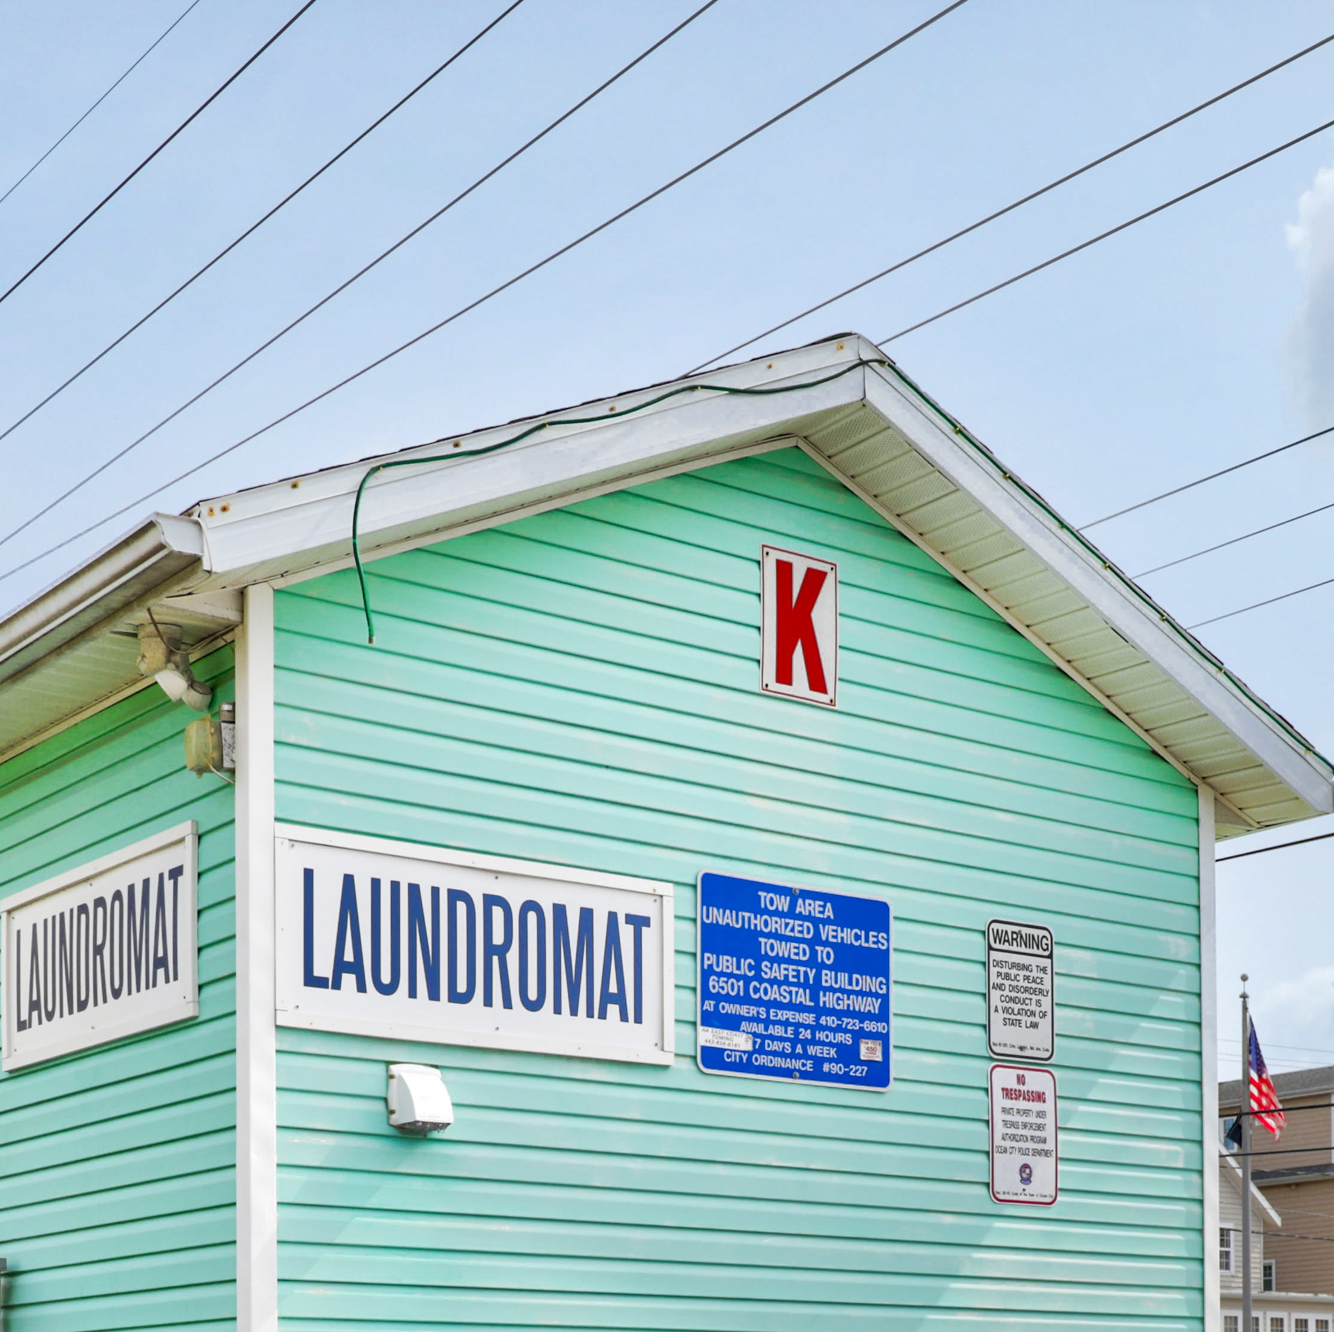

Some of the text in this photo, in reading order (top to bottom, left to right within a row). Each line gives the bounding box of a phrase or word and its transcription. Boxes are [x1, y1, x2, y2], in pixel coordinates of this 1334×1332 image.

[775, 558, 828, 695] K
[758, 891, 834, 919] TOW AREA
[702, 905, 888, 949] UNAUTHORIZED VEHICLES
[16, 863, 184, 1033] LAUNDROMAT
[303, 867, 651, 1025] LAUNDROMAT
[991, 927, 1050, 952] WARNING
[758, 937, 834, 964] TOWED TO
[703, 952, 887, 994] PUBLIC SAFETY BUILDING
[992, 959, 1048, 975] DISTURBING THE
[997, 971, 1044, 985] PUBLIC PEACE
[709, 975, 881, 1014] 6501 COASTAL HIGHWAY
[992, 982, 1049, 997] AND DISORDERLY
[1000, 994, 1042, 1008] CONDUCT IS
[703, 1000, 888, 1033] AT OWNER'S EXPENSE 410-723-6610
[994, 1005, 1048, 1019] A VIOLATION OF
[739, 1021, 794, 1038] AVAILABLE
[799, 1027, 812, 1039] 24
[816, 1030, 852, 1044] HOURS
[1003, 1017, 1039, 1030] STATE LAW
[712, 1034, 734, 1042] TOWING
[754, 1038, 762, 1049] 7
[765, 1040, 792, 1053] DAYS
[795, 1043, 803, 1054] A
[807, 1044, 837, 1058] WEEK
[723, 1050, 868, 1077] CITY ORDINANCE #90-227
[1016, 1074, 1026, 1086] NO
[1001, 1087, 1046, 1104] TRESPASSING
[1001, 1106, 1047, 1119] PRIVATE PROPERTY UNDER
[1002, 1119, 1047, 1132] TRESPASS ENFORCEMENT
[1001, 1133, 1047, 1145] AUTHORIZATION PROGRAM
[995, 1145, 1008, 1154] OCEAN
[1009, 1146, 1017, 1155] CITY
[1018, 1147, 1030, 1157] POLICE
